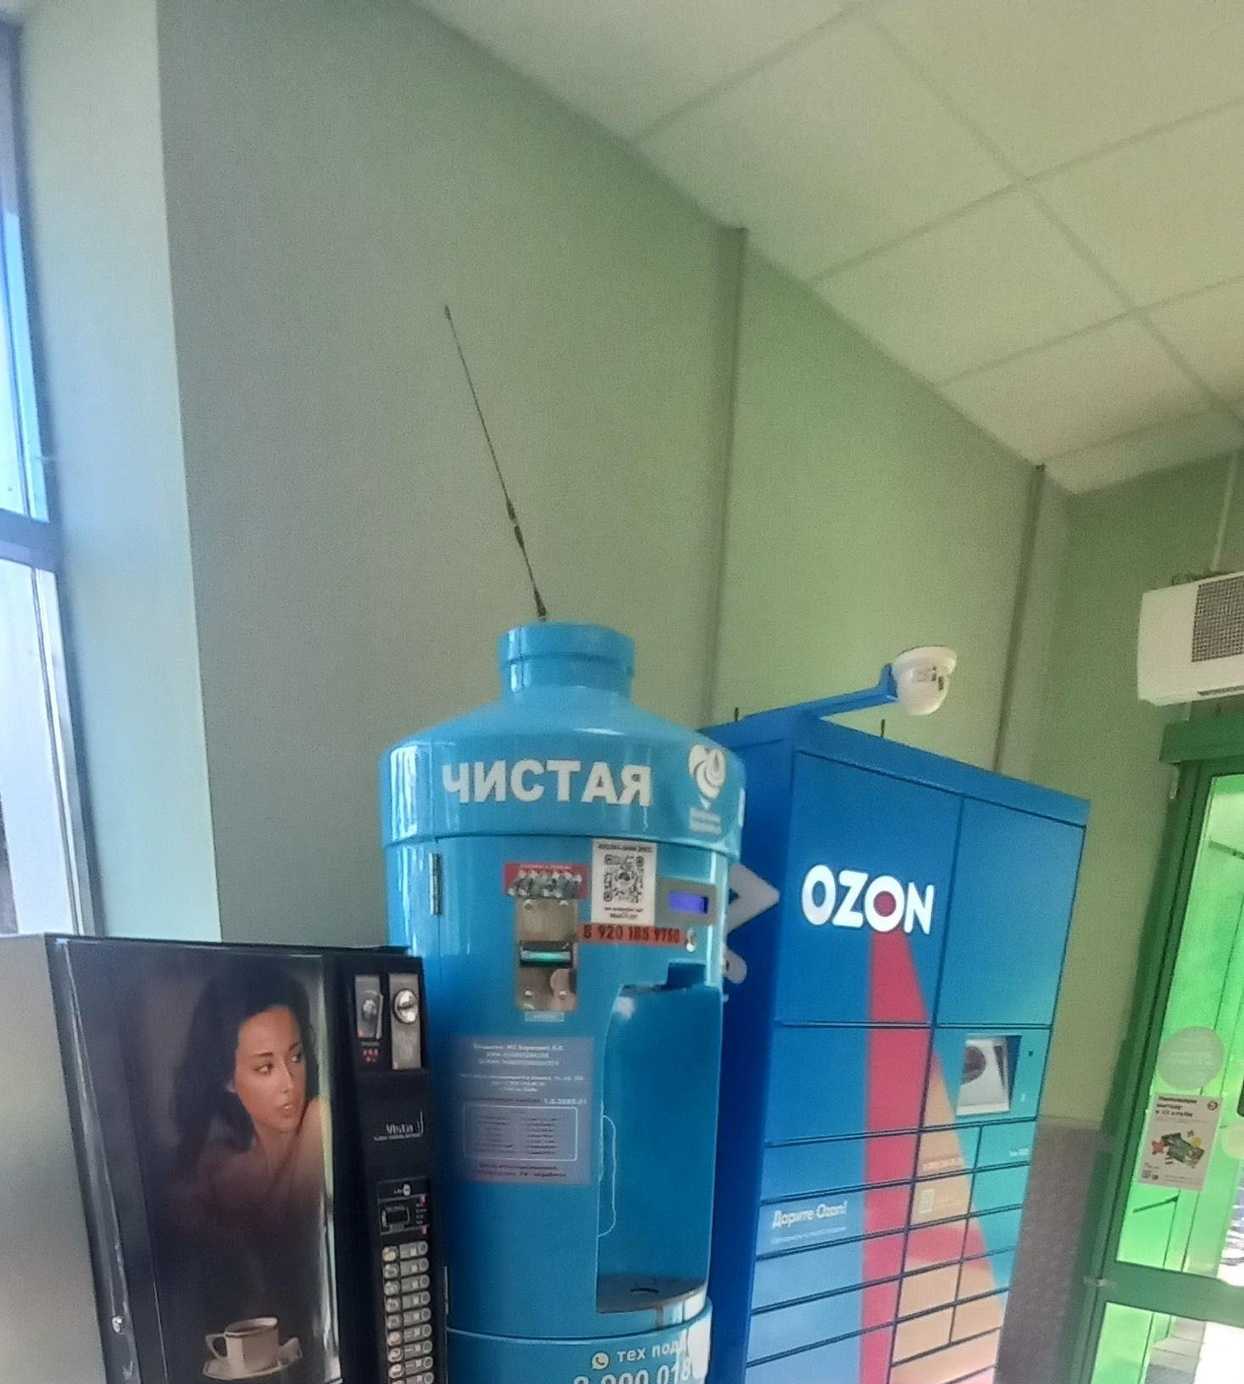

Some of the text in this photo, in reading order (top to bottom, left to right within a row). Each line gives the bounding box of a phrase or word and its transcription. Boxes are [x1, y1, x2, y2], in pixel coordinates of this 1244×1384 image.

[442, 759, 653, 806] ЧИСТАЯ
[801, 864, 935, 935] OZON
[598, 924, 623, 940] 920
[617, 1347, 646, 1362] тех
